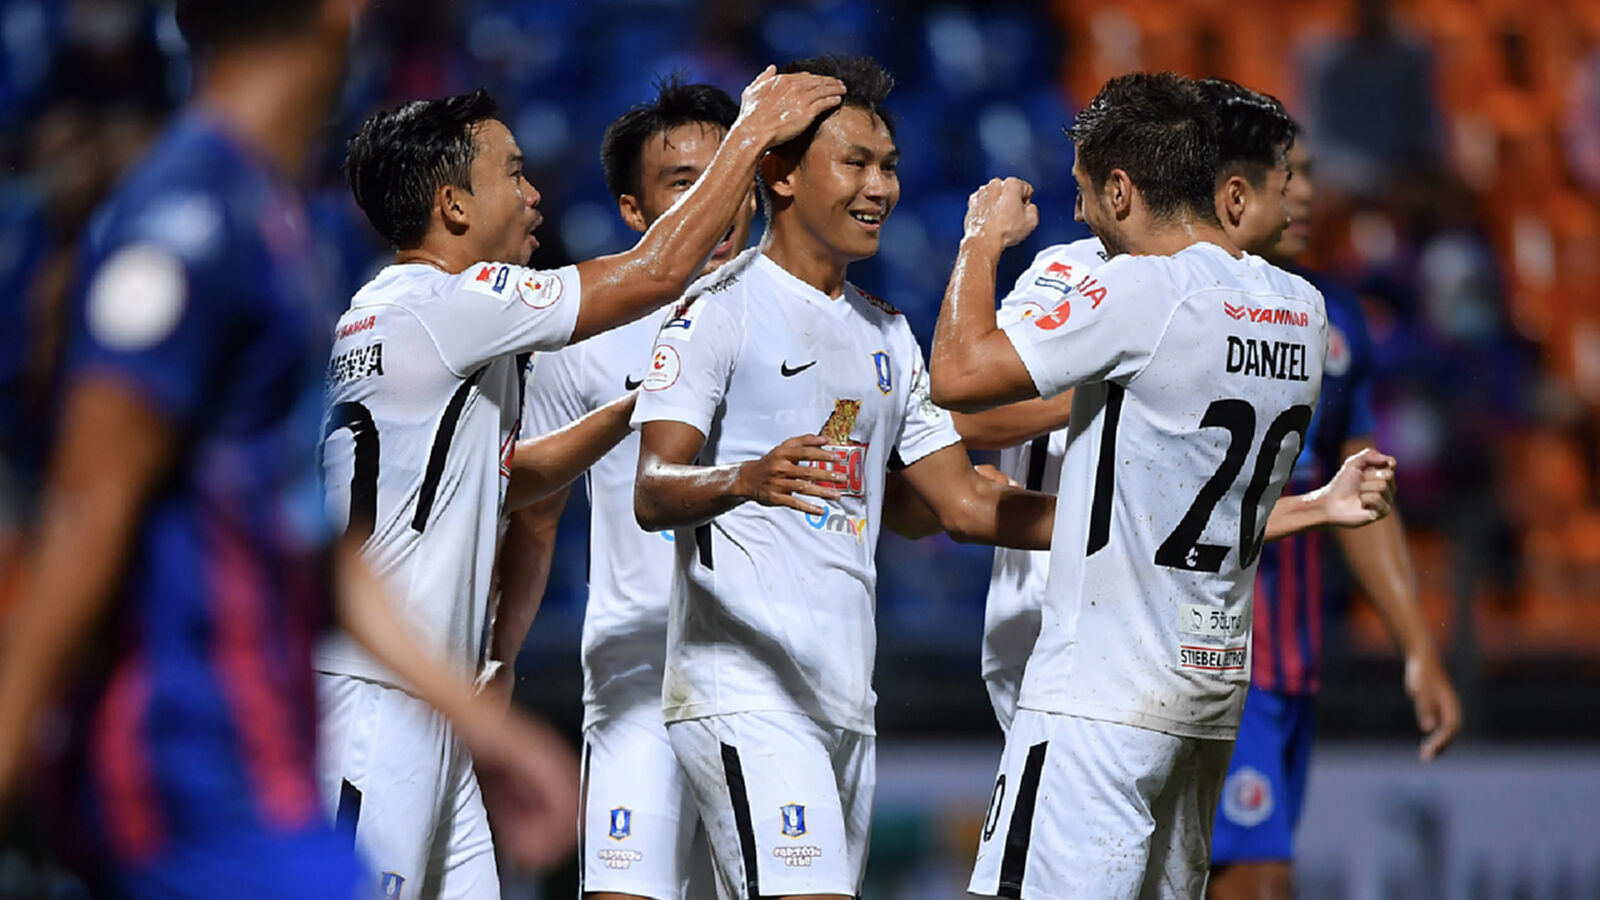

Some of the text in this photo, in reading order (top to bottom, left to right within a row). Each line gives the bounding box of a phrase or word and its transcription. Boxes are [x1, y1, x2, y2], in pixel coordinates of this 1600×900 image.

[1247, 307, 1309, 328] YANMAR
[1226, 335, 1310, 382] DANIEL
[1154, 398, 1312, 571] 20
[1180, 649, 1222, 667] STIEBEL
